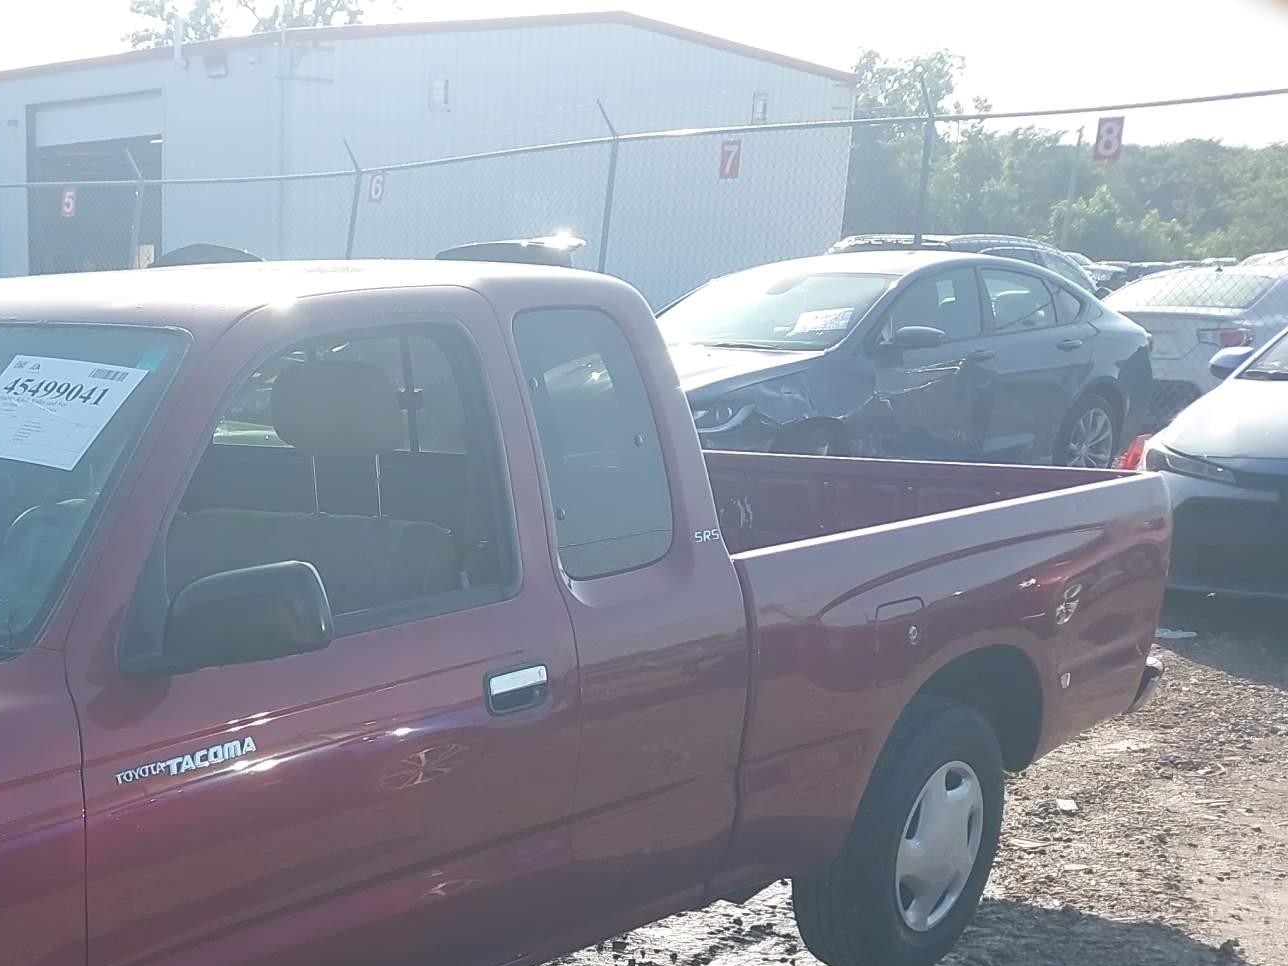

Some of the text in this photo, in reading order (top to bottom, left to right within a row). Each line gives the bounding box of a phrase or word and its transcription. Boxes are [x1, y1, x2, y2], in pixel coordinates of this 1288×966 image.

[1098, 122, 1120, 155] 8
[724, 145, 739, 174] 7
[371, 175, 382, 199] 6
[63, 192, 74, 212] 5
[3, 377, 110, 406] 45499041
[115, 736, 257, 785] TOYOTA TACOMA
